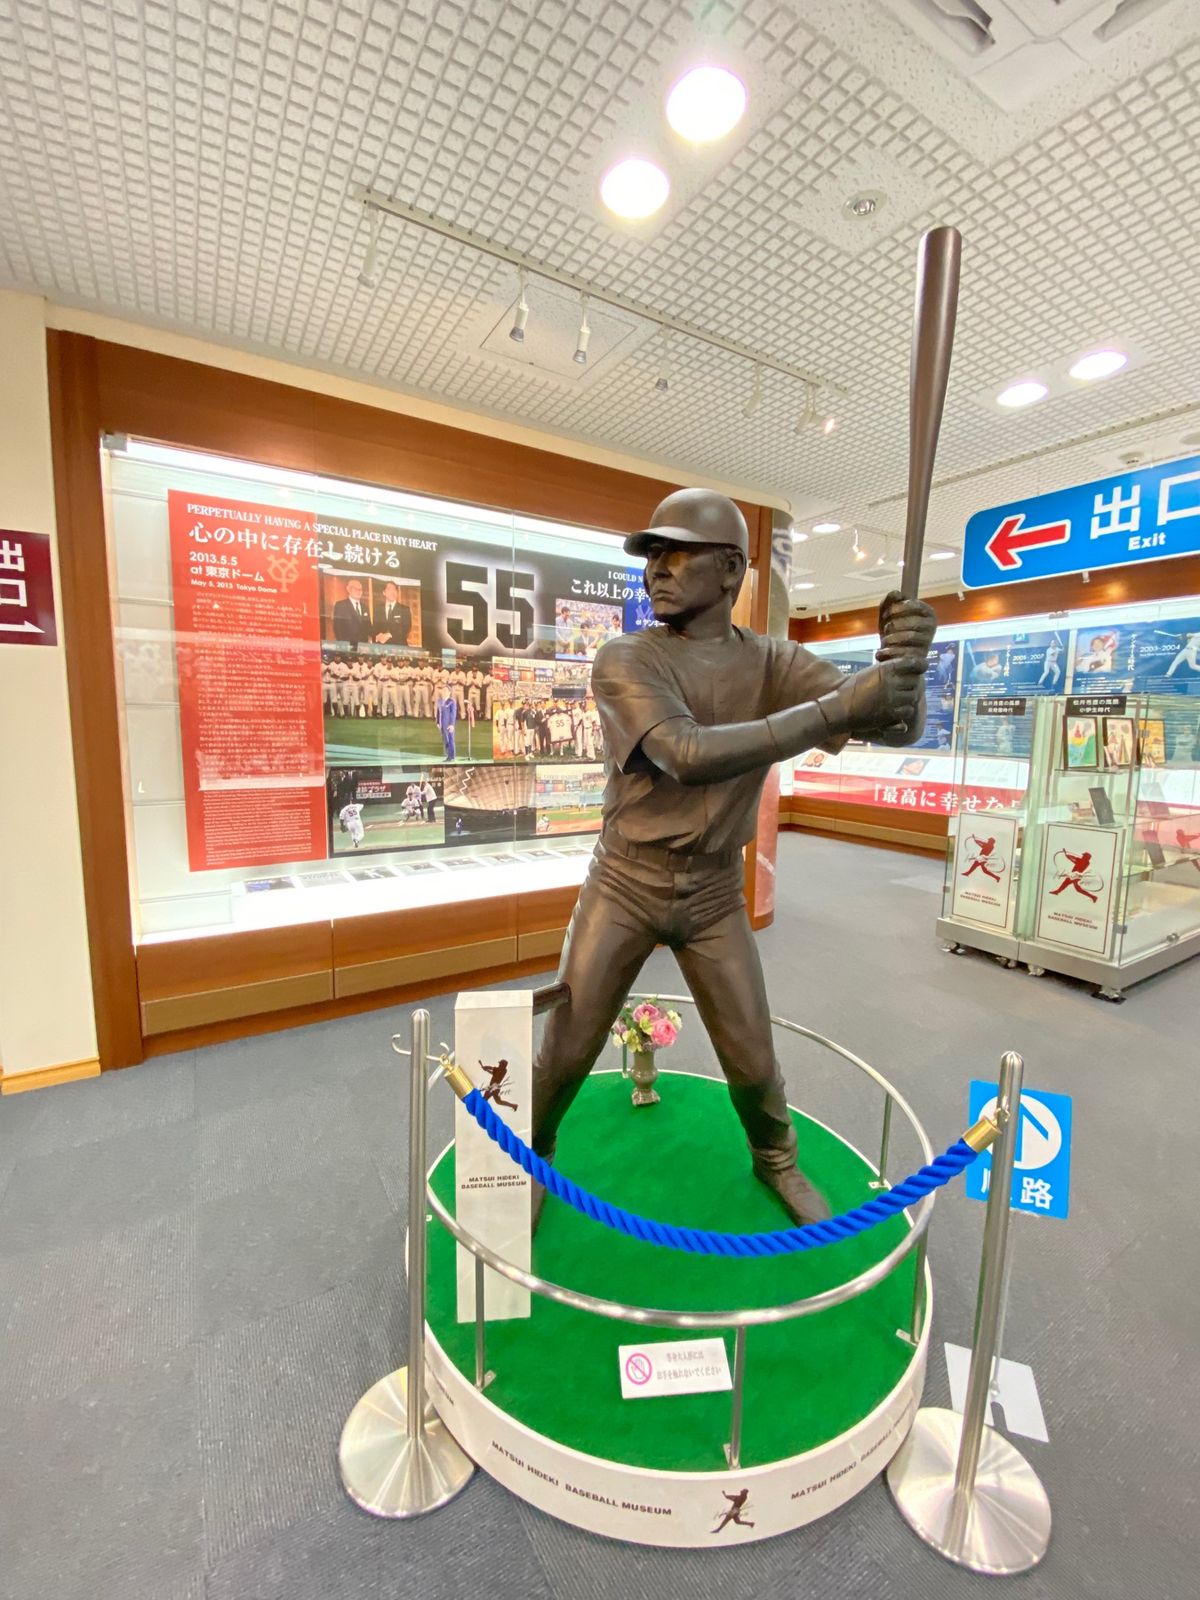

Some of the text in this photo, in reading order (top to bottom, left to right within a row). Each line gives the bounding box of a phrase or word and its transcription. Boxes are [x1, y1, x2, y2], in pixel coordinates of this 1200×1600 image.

[1090, 470, 1200, 540] 出口
[187, 503, 438, 551] PERPETUALLY HAVING A SPECIAL PLACE IN MY HEART
[189, 521, 400, 568] 心の中に存在し続ける
[1128, 532, 1166, 550] Exit
[189, 551, 238, 566] 2013.5.5
[190, 565, 265, 582] at 東京ドーム
[608, 571, 612, 579] I
[613, 573, 636, 582] COULD
[191, 579, 206, 588] May
[217, 581, 233, 589] 2013
[236, 583, 256, 593] Tokyo
[257, 586, 278, 594] Dome
[445, 560, 535, 650] 55
[491, 1440, 672, 1516] MATSUI HIDEKI BASEBALL MUSEUM
[791, 1479, 827, 1500] MATSUI
[830, 1461, 857, 1482] HIDEKI
